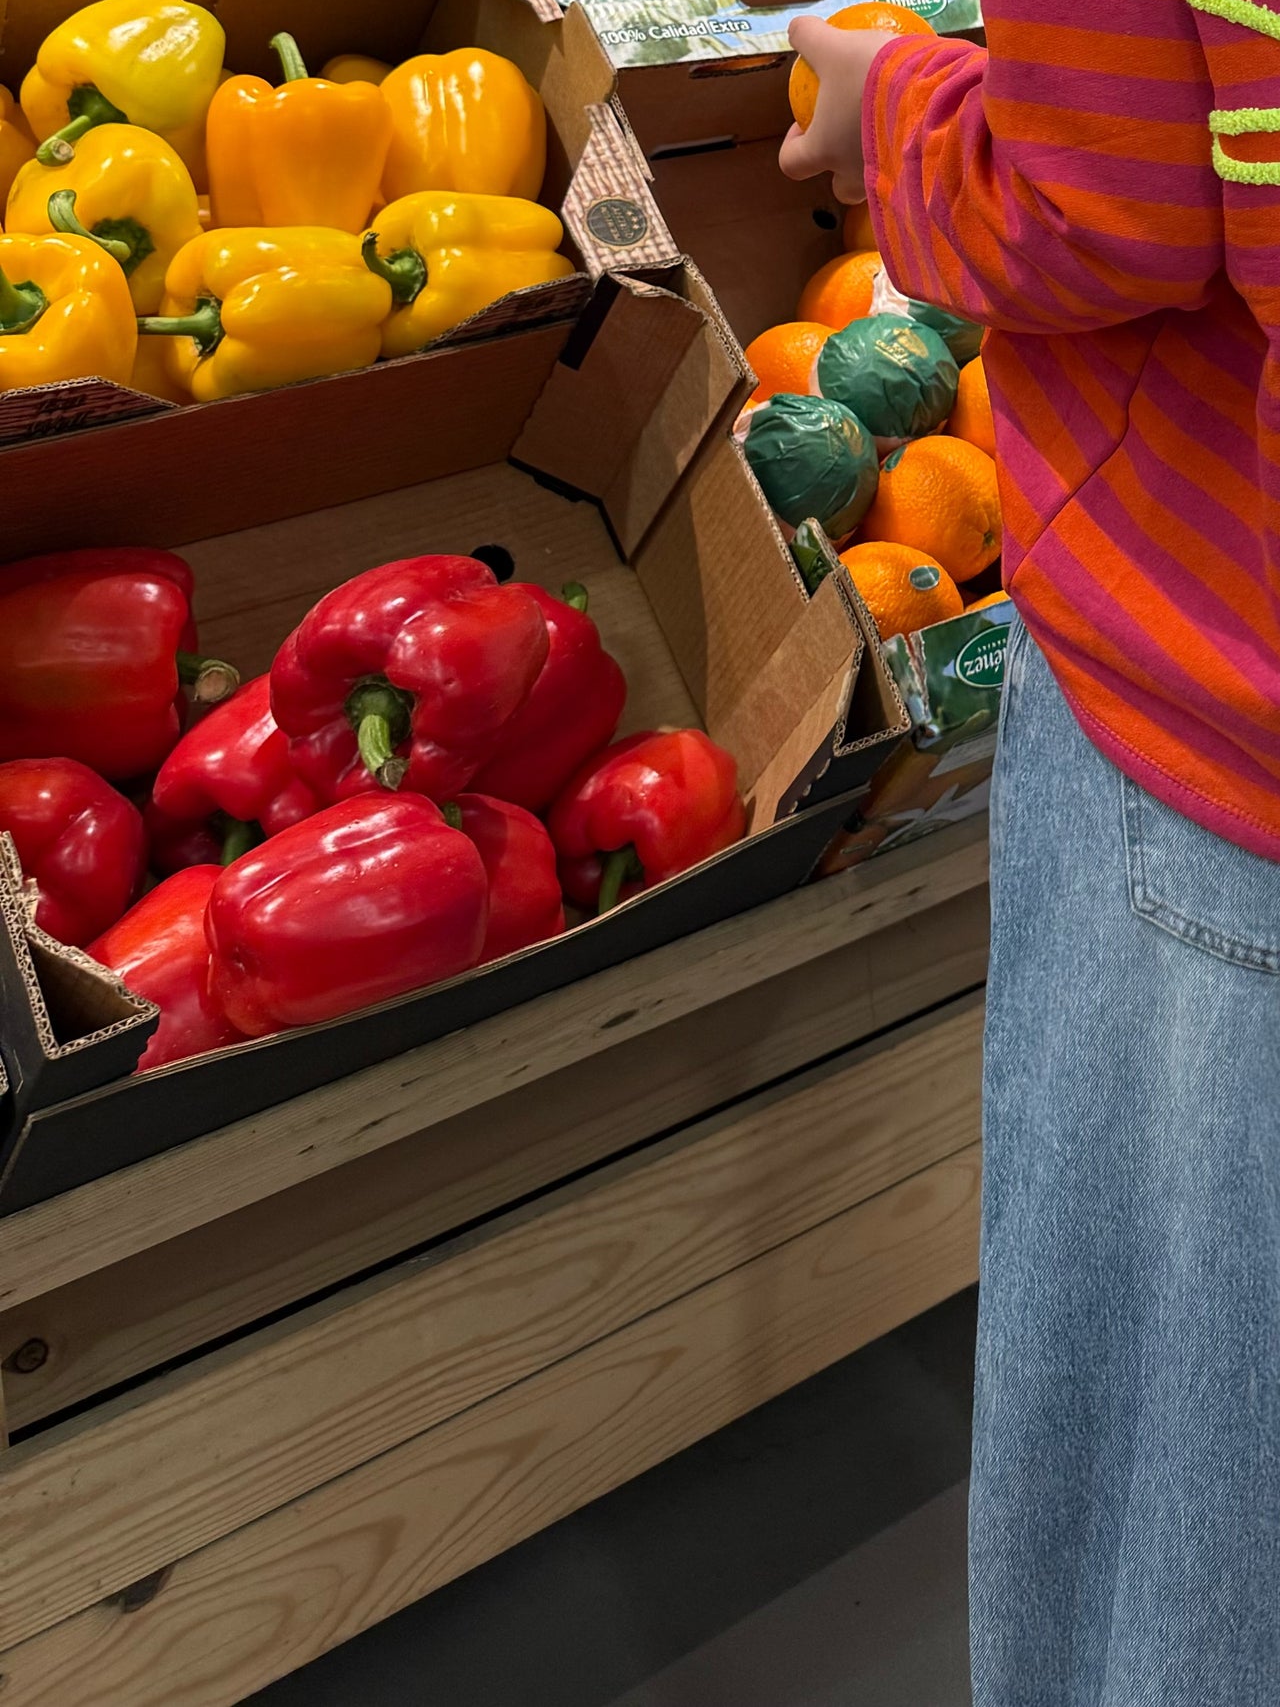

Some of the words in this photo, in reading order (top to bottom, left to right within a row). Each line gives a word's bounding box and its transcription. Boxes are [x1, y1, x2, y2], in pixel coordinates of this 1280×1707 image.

[600, 29, 647, 46] 100%
[648, 22, 707, 40] Calidad
[711, 19, 751, 34] Extra
[963, 645, 1008, 677] énez
